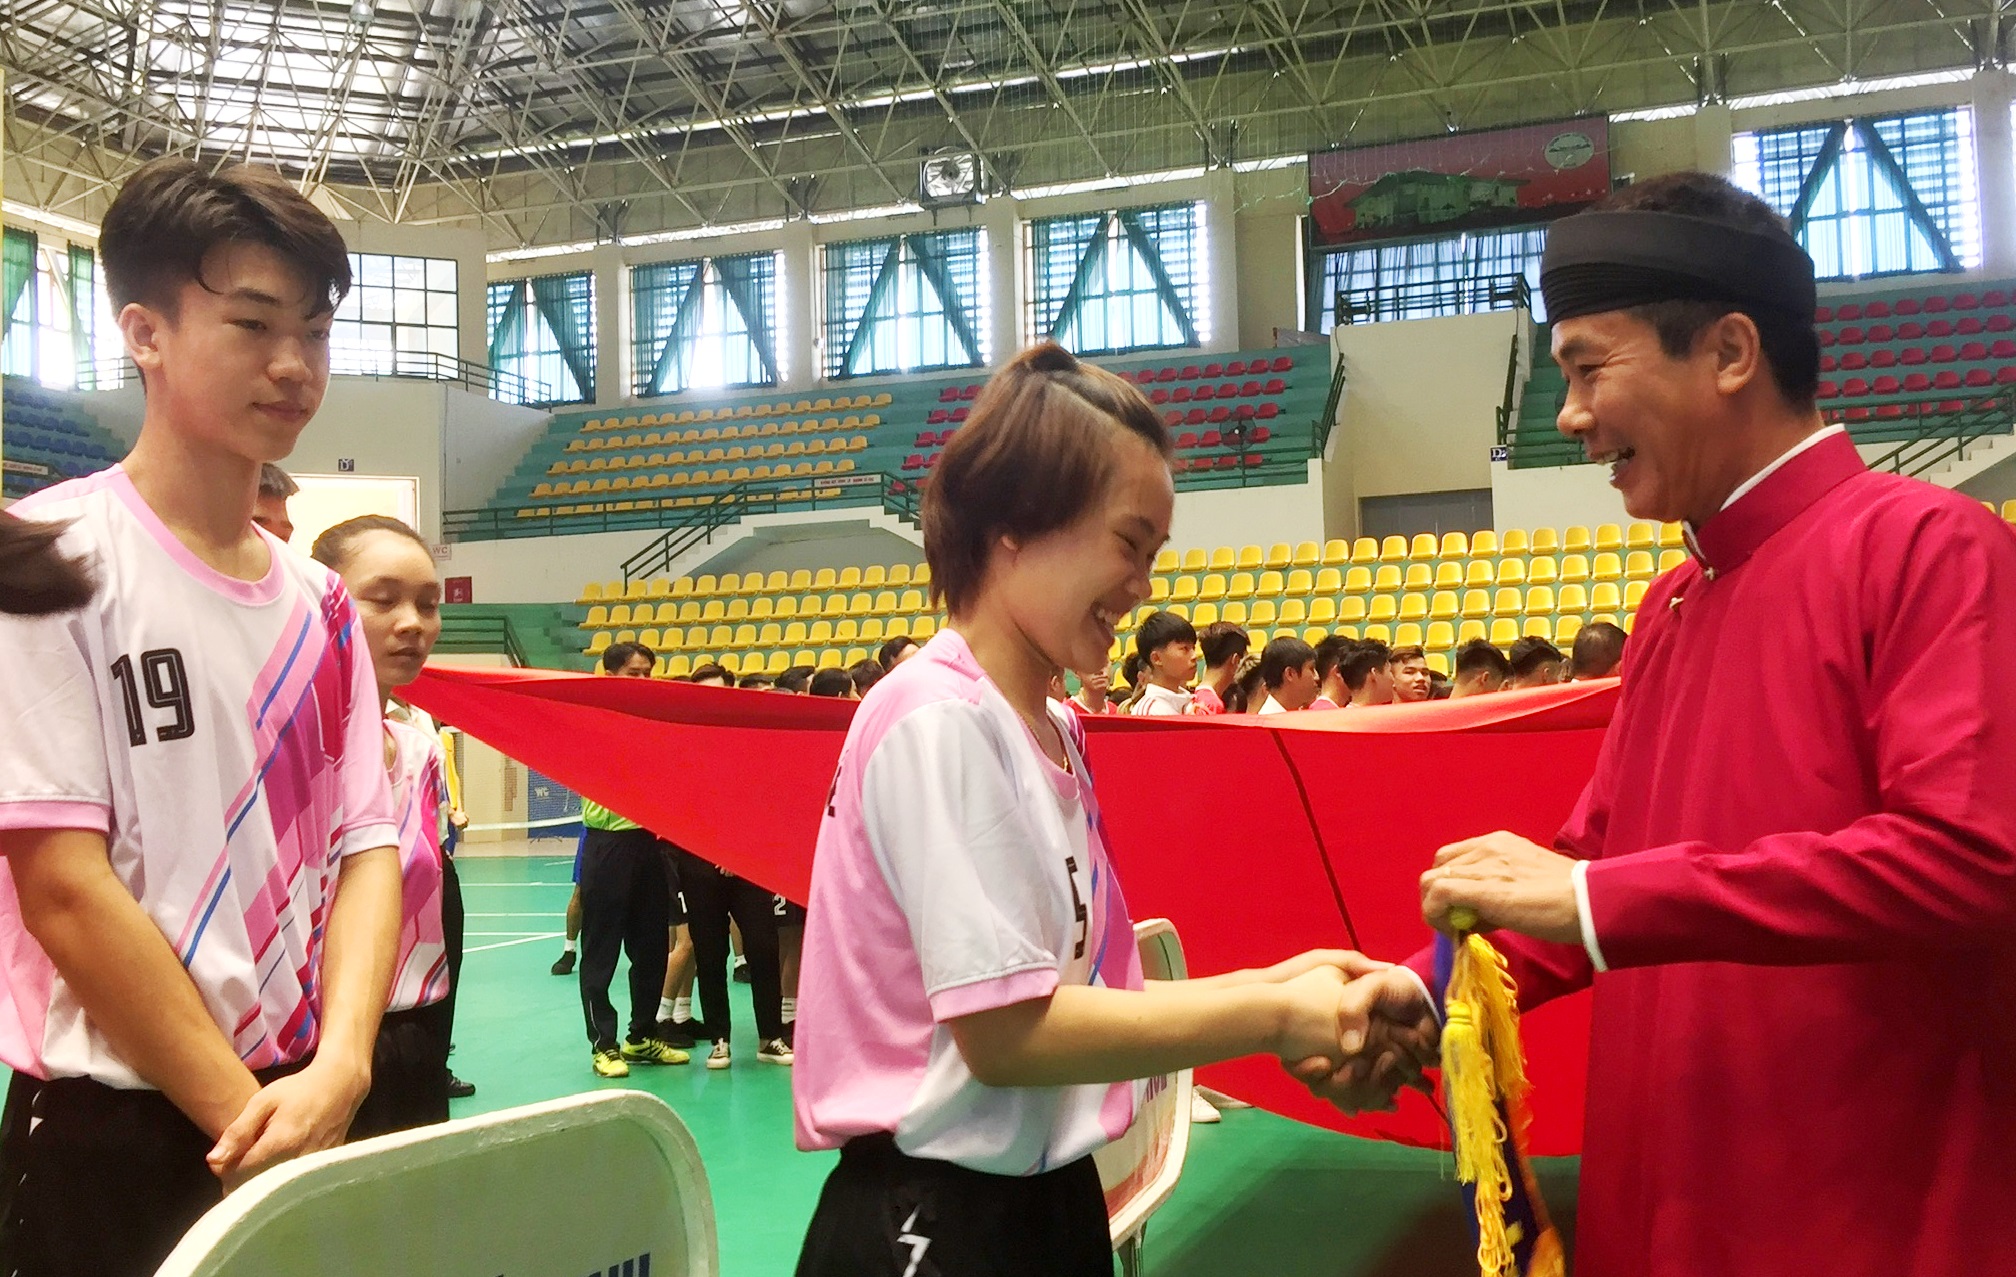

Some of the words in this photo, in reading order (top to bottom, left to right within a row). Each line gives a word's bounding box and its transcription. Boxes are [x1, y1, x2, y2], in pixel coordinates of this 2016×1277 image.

[432, 546, 448, 554] WC
[110, 648, 195, 748] 19
[773, 893, 787, 916] 2
[1065, 855, 1088, 961] 5
